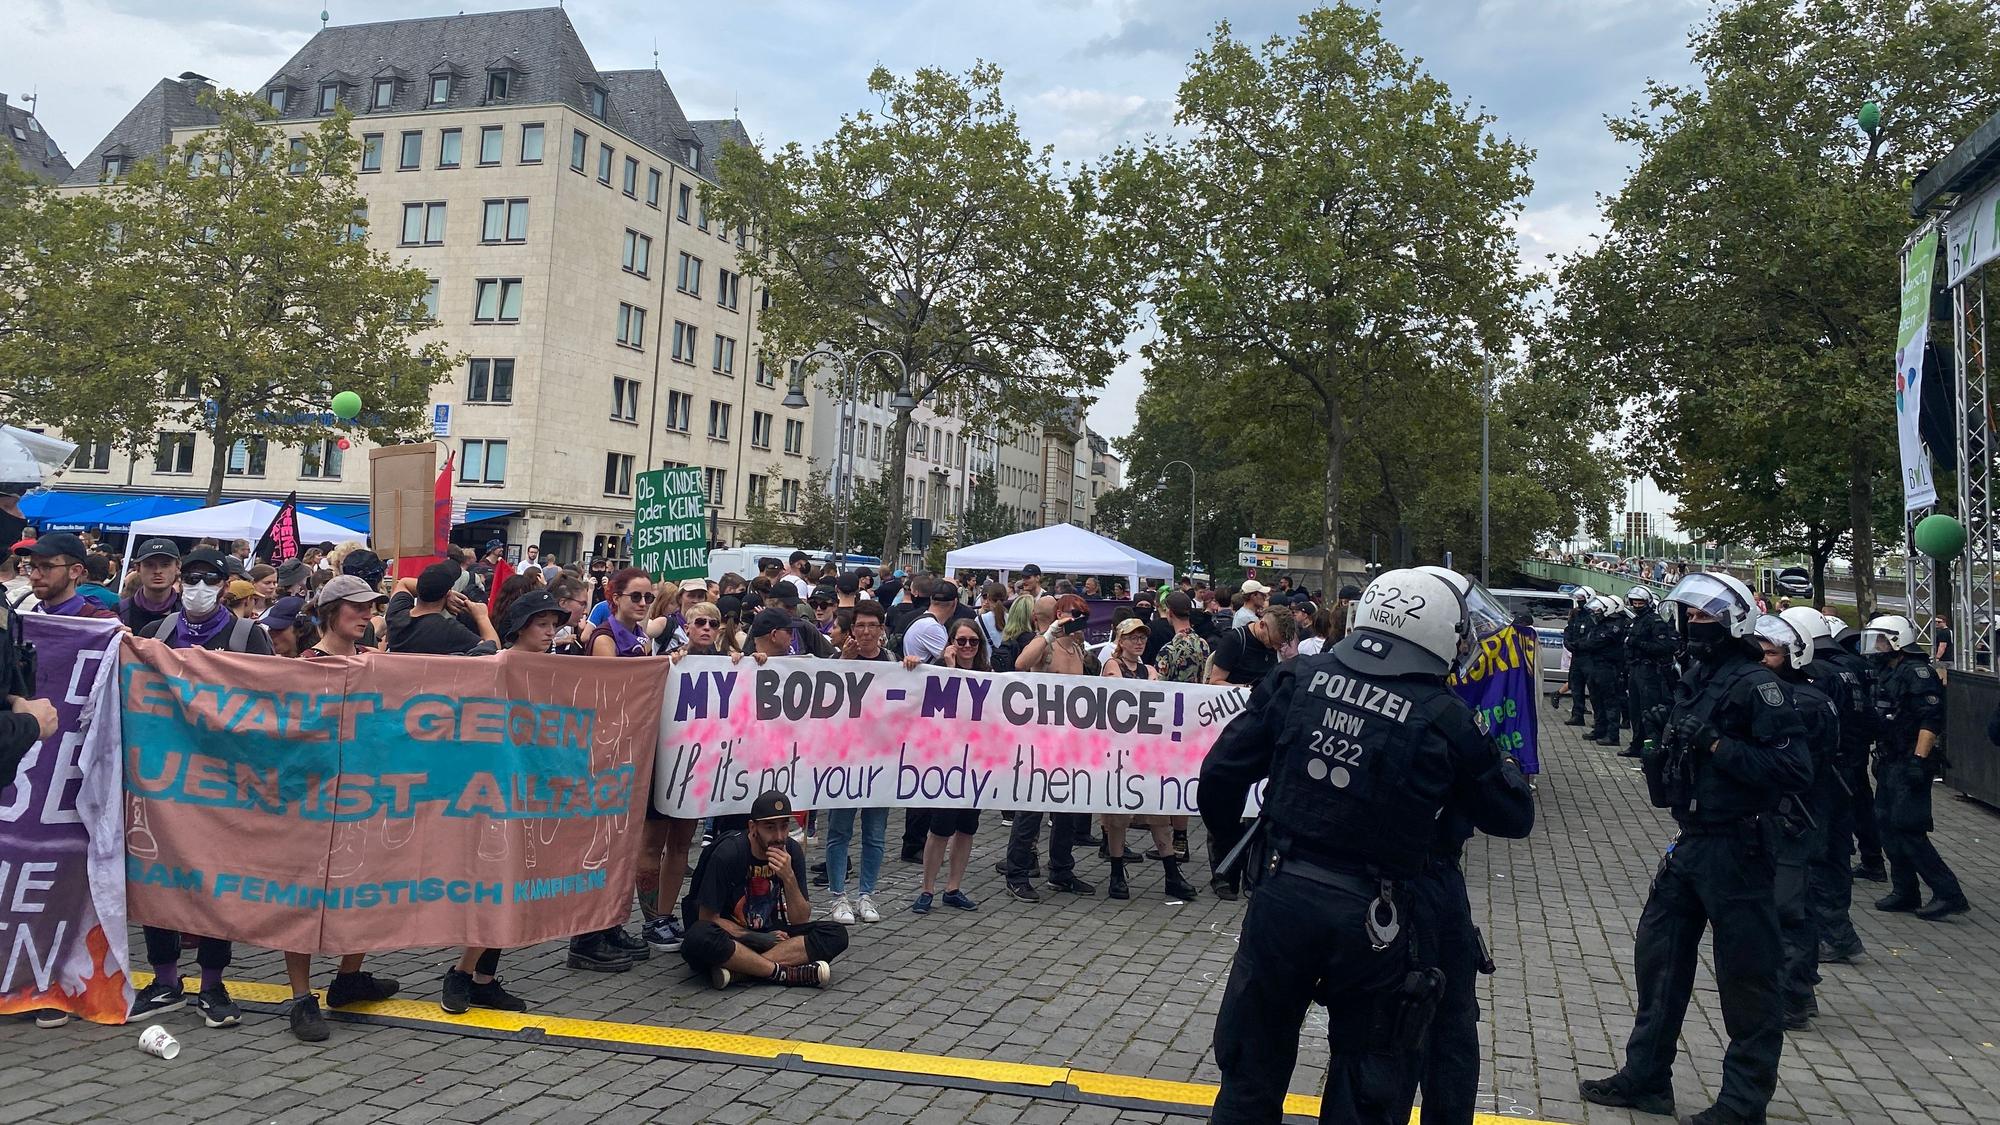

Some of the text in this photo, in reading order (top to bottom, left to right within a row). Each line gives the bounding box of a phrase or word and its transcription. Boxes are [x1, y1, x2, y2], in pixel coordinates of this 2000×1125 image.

[638, 470, 704, 500] Ob KINDER
[668, 495, 705, 520] KEINE
[638, 523, 701, 549] BESTIMMEN
[641, 547, 707, 573] WIR ALLEINE
[1364, 583, 1426, 620] 6-2-2
[1369, 607, 1407, 629] NRW
[673, 671, 738, 722] MY
[756, 669, 875, 721] BODY
[920, 675, 992, 721] MY
[1198, 686, 1247, 727] SHUT
[1307, 670, 1413, 724] POLIZEI
[404, 699, 592, 749] GEGEN
[1322, 707, 1365, 737] NRW
[1308, 730, 1363, 767] 2622
[304, 772, 428, 815] IST
[455, 771, 630, 813] ALLTAG!
[666, 742, 701, 809] If
[758, 741, 800, 801] not
[812, 765, 884, 805] your
[1013, 744, 1091, 805] then
[213, 873, 504, 910] FEMINISTISCH
